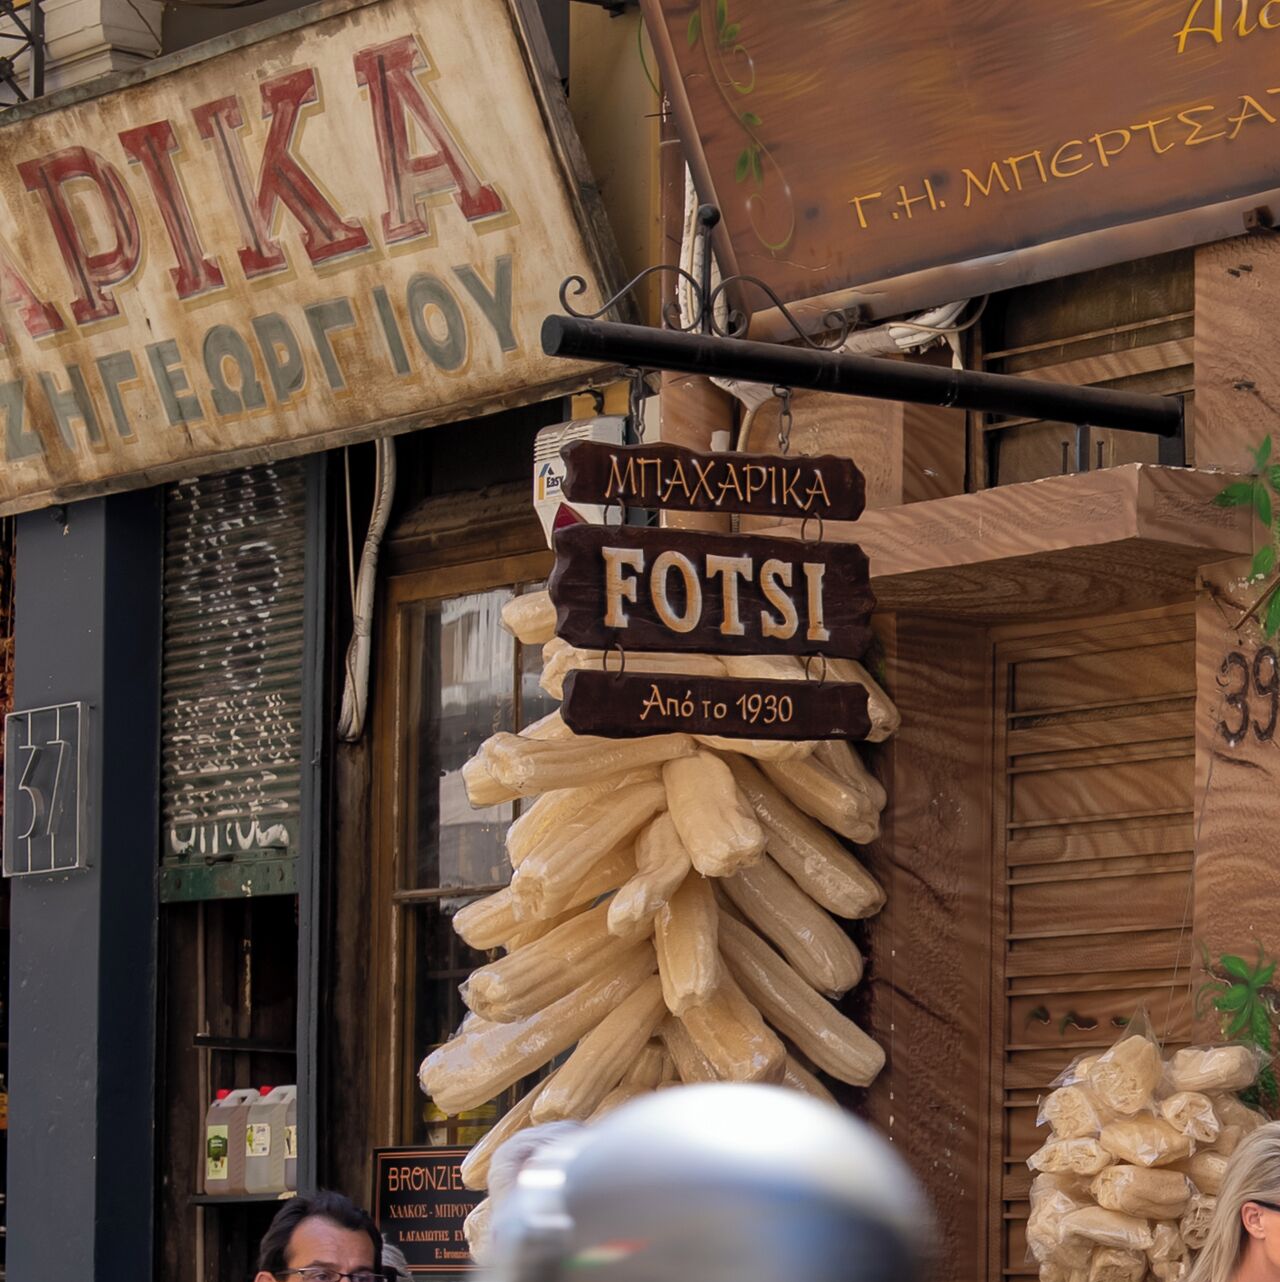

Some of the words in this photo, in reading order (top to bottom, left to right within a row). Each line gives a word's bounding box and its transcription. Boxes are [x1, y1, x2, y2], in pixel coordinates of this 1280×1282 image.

[604, 454, 831, 511] ΜΠΑΧΑΡΙΚΑ
[602, 546, 830, 642] FOTSI
[640, 684, 694, 721] Από
[735, 694, 793, 724] 1930
[1216, 645, 1280, 747] 39
[18, 739, 65, 839] 37
